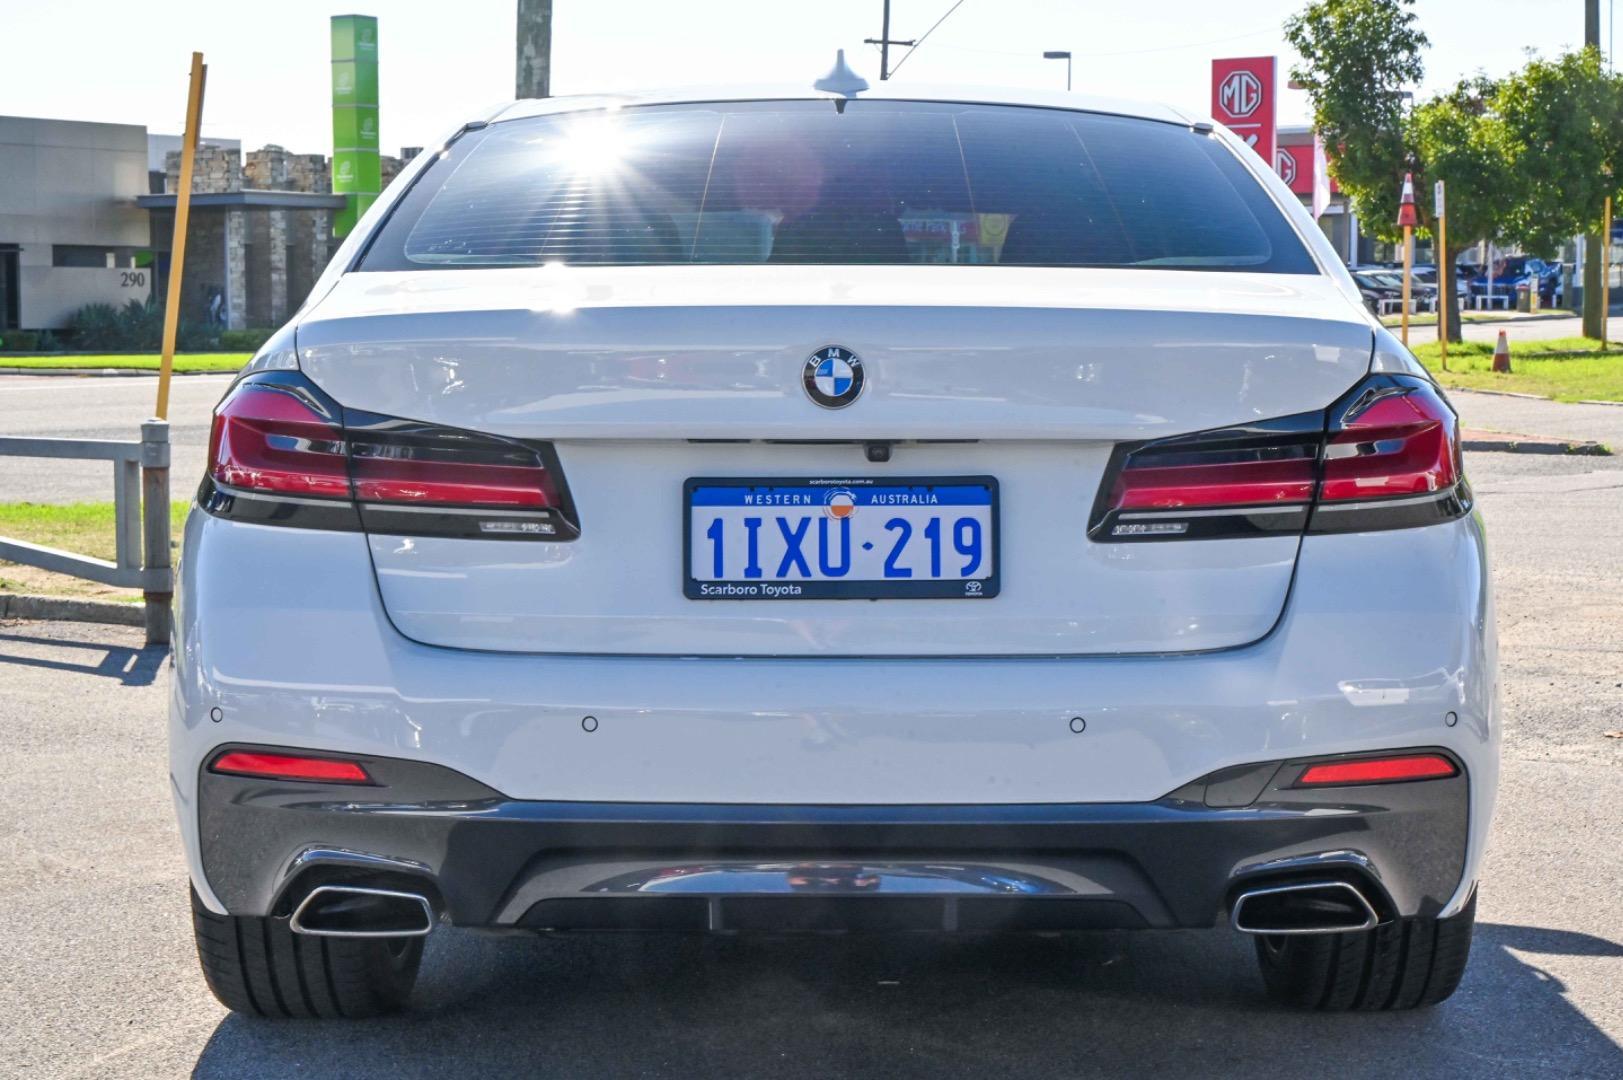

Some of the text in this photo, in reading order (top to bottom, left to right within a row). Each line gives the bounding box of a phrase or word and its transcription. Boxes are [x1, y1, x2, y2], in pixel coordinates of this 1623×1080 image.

[1223, 75, 1257, 113] MG
[120, 271, 145, 287] 290
[809, 348, 860, 367] BMW
[744, 494, 938, 505] WESTERN AUSTRALIA
[700, 583, 803, 597] Scarboro Toyota
